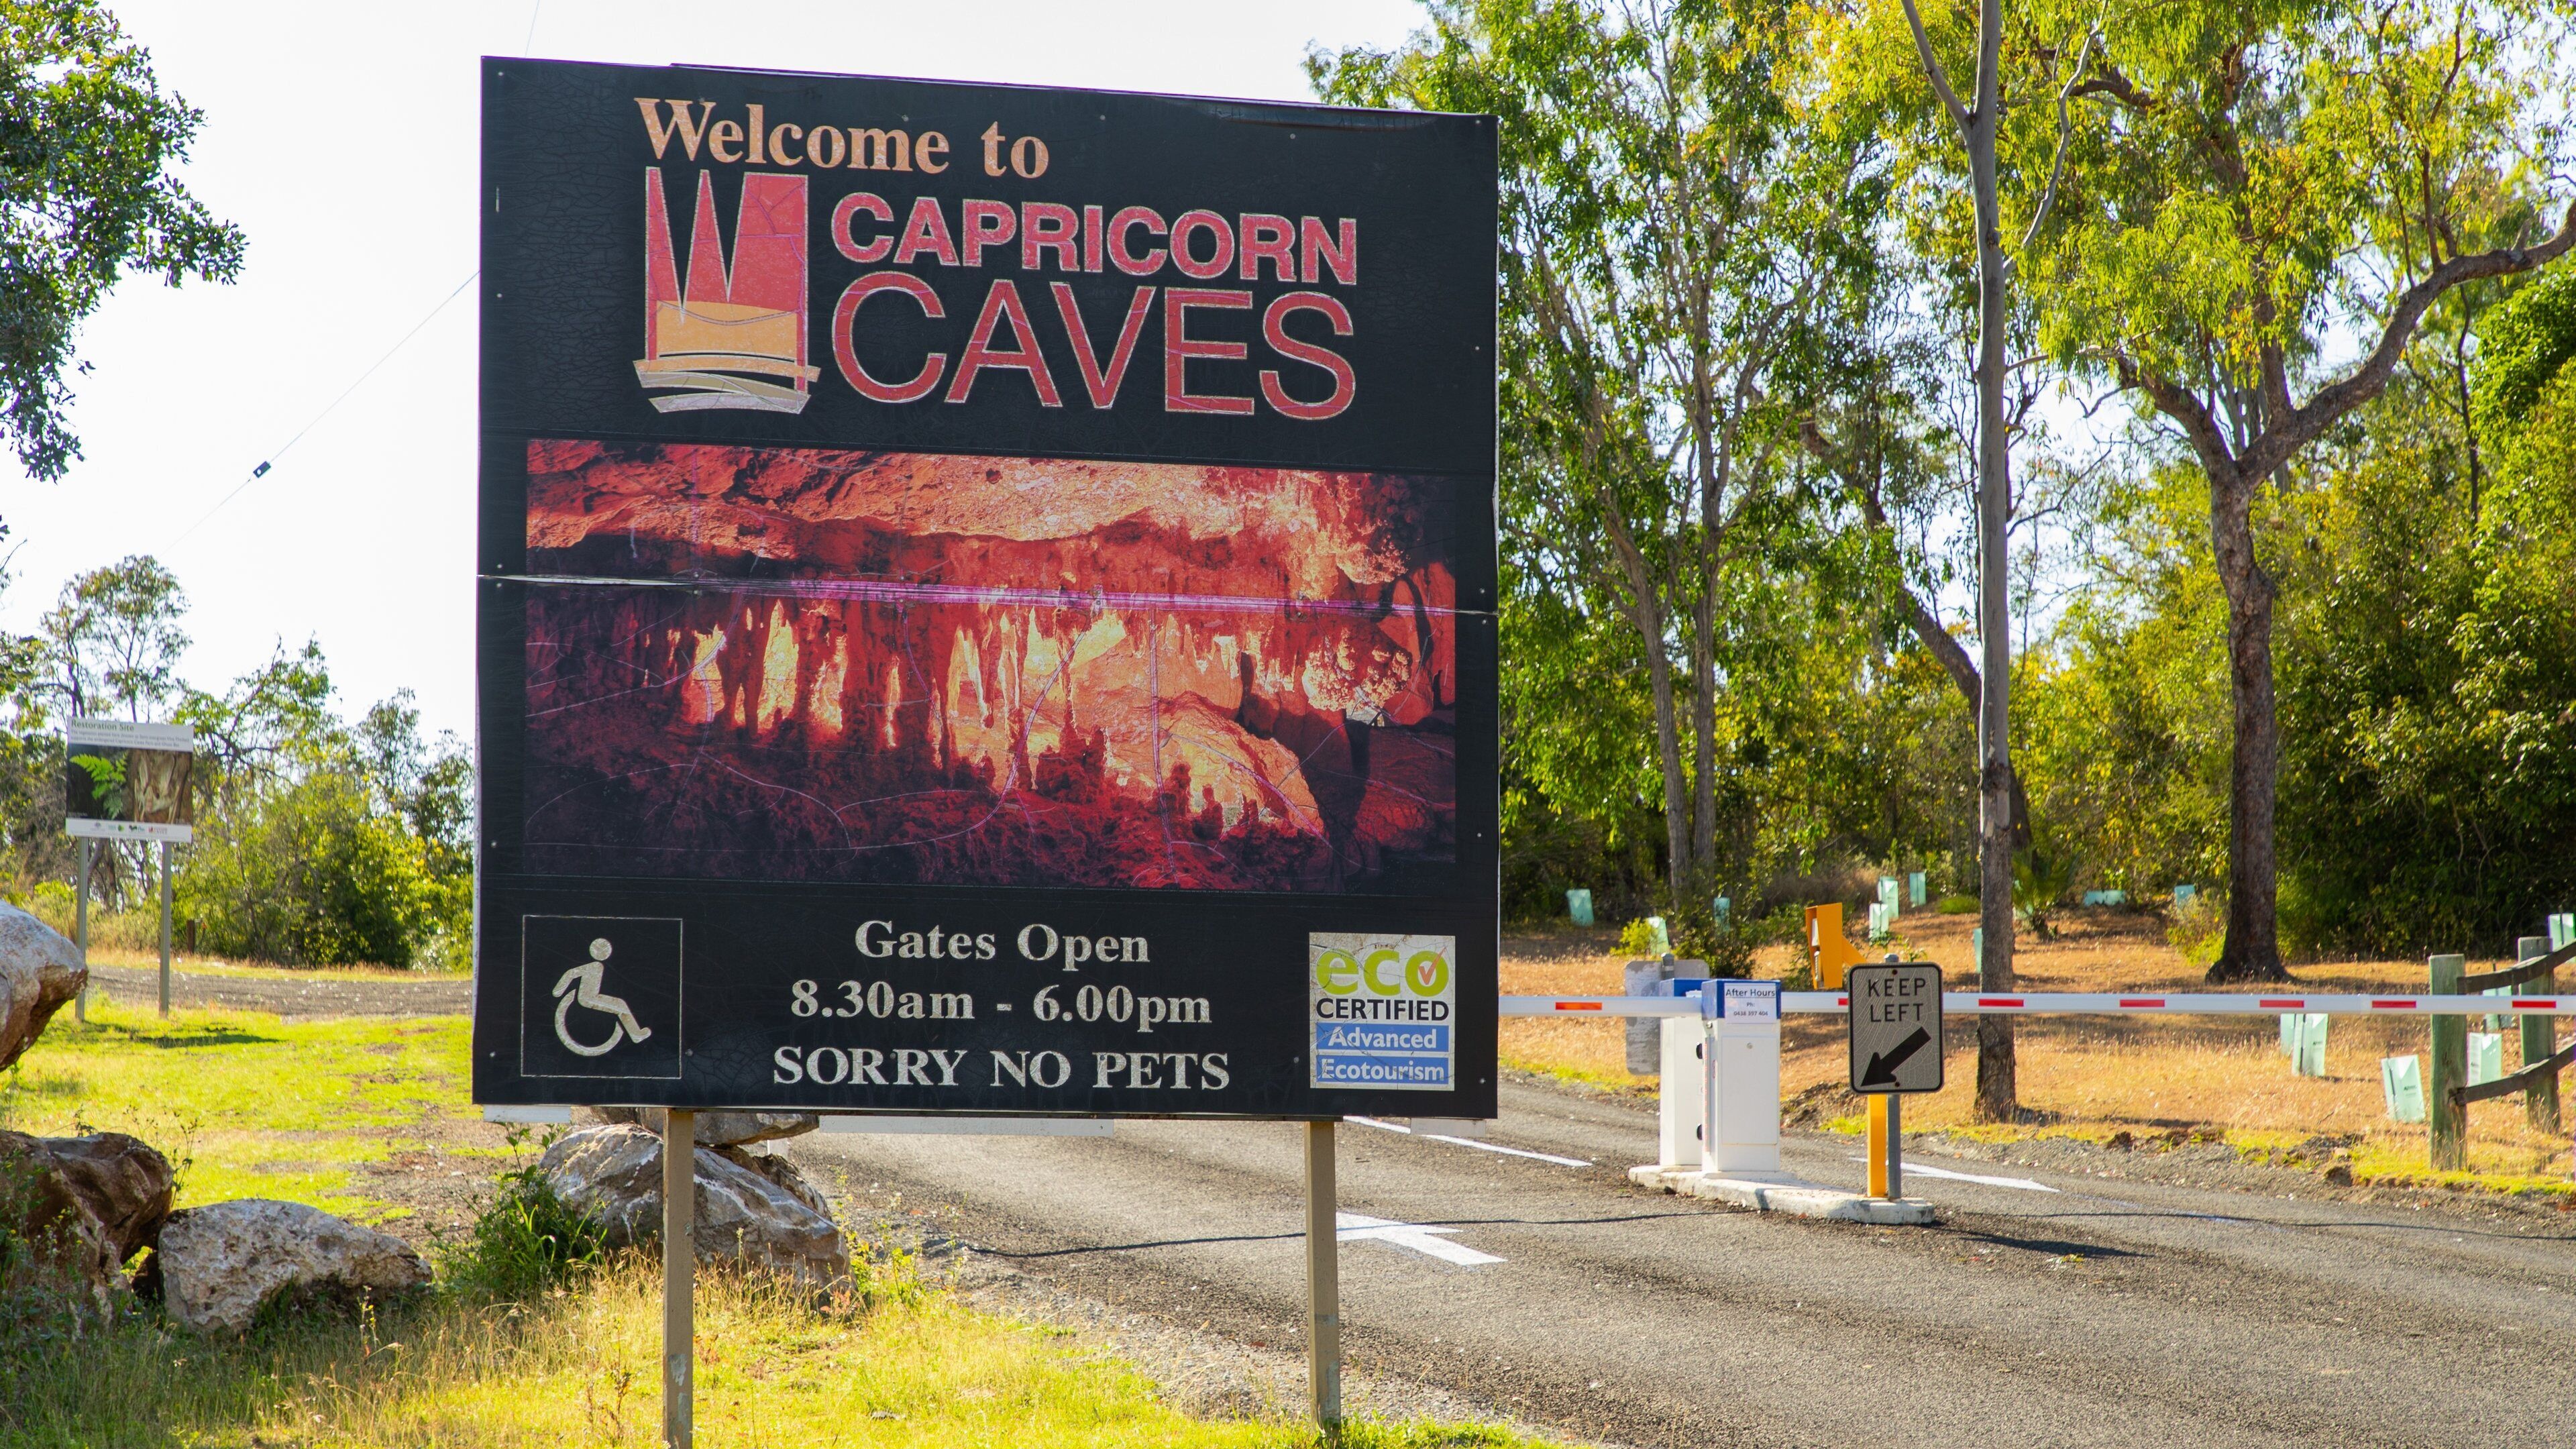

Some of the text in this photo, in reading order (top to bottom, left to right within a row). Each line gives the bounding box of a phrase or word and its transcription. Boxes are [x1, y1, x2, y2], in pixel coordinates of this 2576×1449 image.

[634, 97, 1049, 178] Welcome to
[830, 192, 1357, 285] CAPRICORN
[831, 270, 1356, 420] CAVES
[71, 719, 134, 733] Restoration Site
[855, 920, 1150, 971] Gates Open
[1316, 948, 1449, 998] eco
[1866, 977, 1927, 998] KEEP
[791, 979, 1212, 1032] 8.30am - 6.00pm
[1725, 988, 1775, 997] After Hours
[1316, 998, 1449, 1021] CERTIFIED
[1869, 1003, 1924, 1023] LEFT
[1328, 1026, 1436, 1049] Advanced
[773, 1046, 1230, 1090] SORRY NO PETS
[1321, 1059, 1444, 1081] Ecotourism
